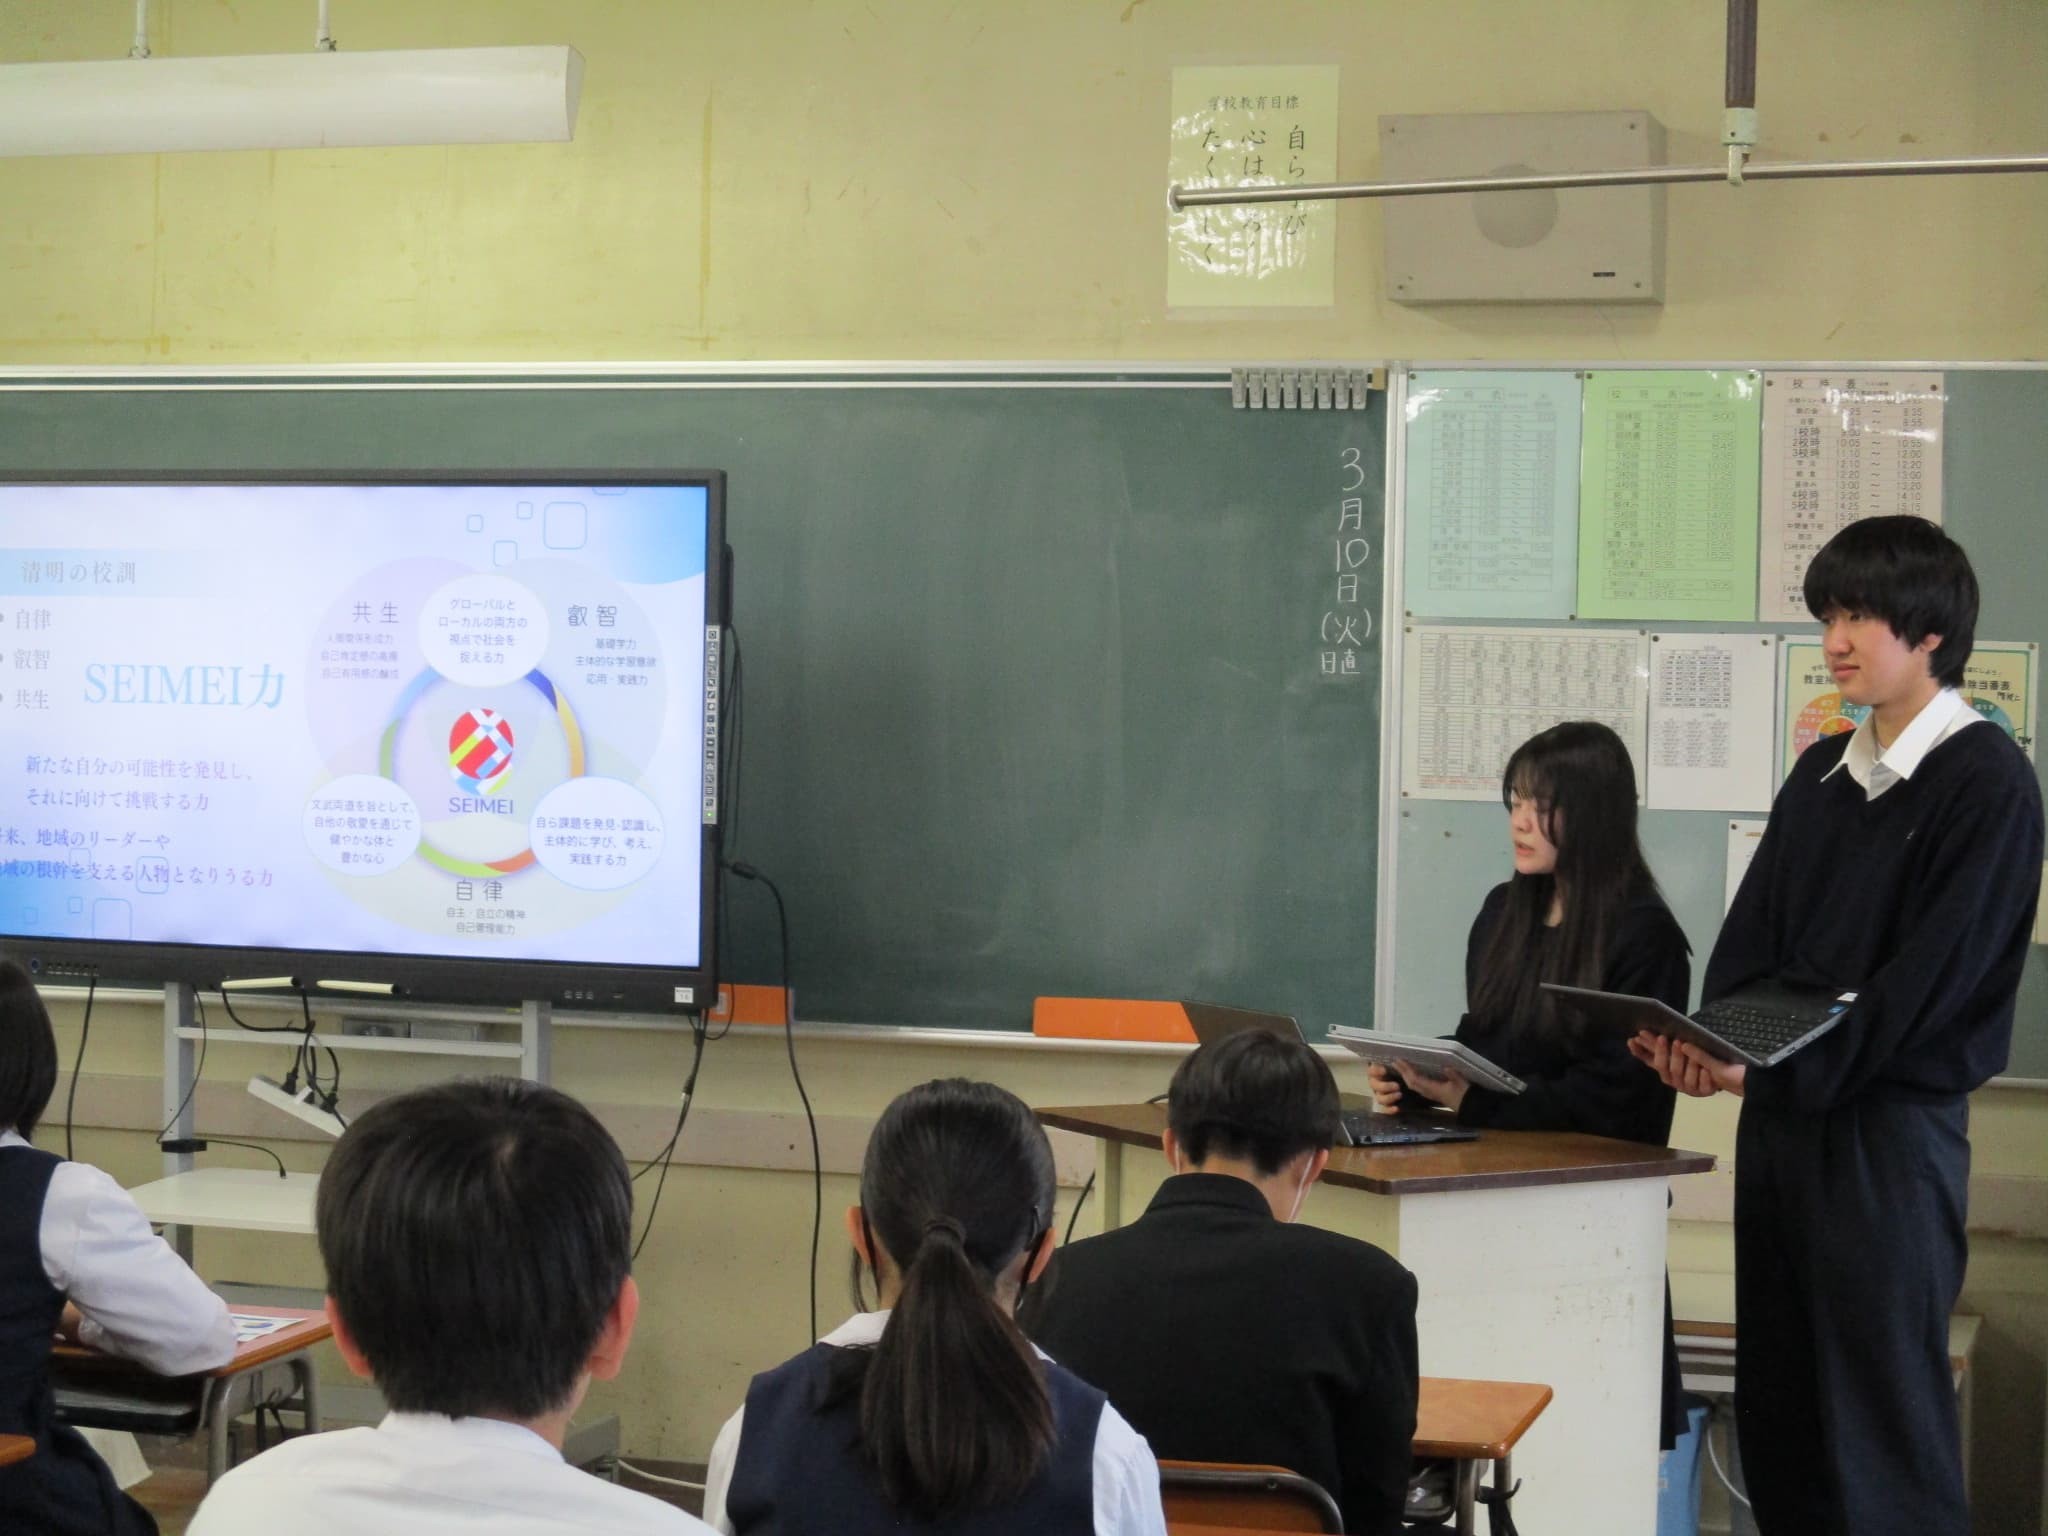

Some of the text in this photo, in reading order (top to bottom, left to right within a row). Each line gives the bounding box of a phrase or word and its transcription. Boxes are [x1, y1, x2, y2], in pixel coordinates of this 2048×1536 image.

[1209, 95, 1300, 111] 学校教育目標
[1285, 125, 1307, 236] 自らび
[20, 560, 137, 585] 清明の校訓
[352, 600, 400, 625] 共生
[449, 599, 516, 611] グローバルと
[568, 604, 618, 628] 叡智
[15, 608, 52, 631] 自律
[438, 616, 528, 629] ローカルの両方の
[449, 633, 516, 647] 視点で社会を
[13, 647, 51, 671] 叡智
[459, 651, 505, 664] 捉える力
[1321, 648, 1361, 675] 日直
[15, 688, 50, 711] 共生
[26, 754, 253, 782] 新たな自分の可能性を発見し、
[26, 787, 209, 812] それに向けて挑戦する力
[448, 796, 515, 815] SEIMEI
[314, 816, 414, 831] 自他の敬愛を通じて
[330, 834, 394, 848] 健やかな体と
[340, 851, 385, 865] 豊かな心
[568, 853, 628, 867] 実践する力
[0, 860, 273, 888] 域の根幹を支える人物となりうる力
[455, 879, 505, 902] 自律
